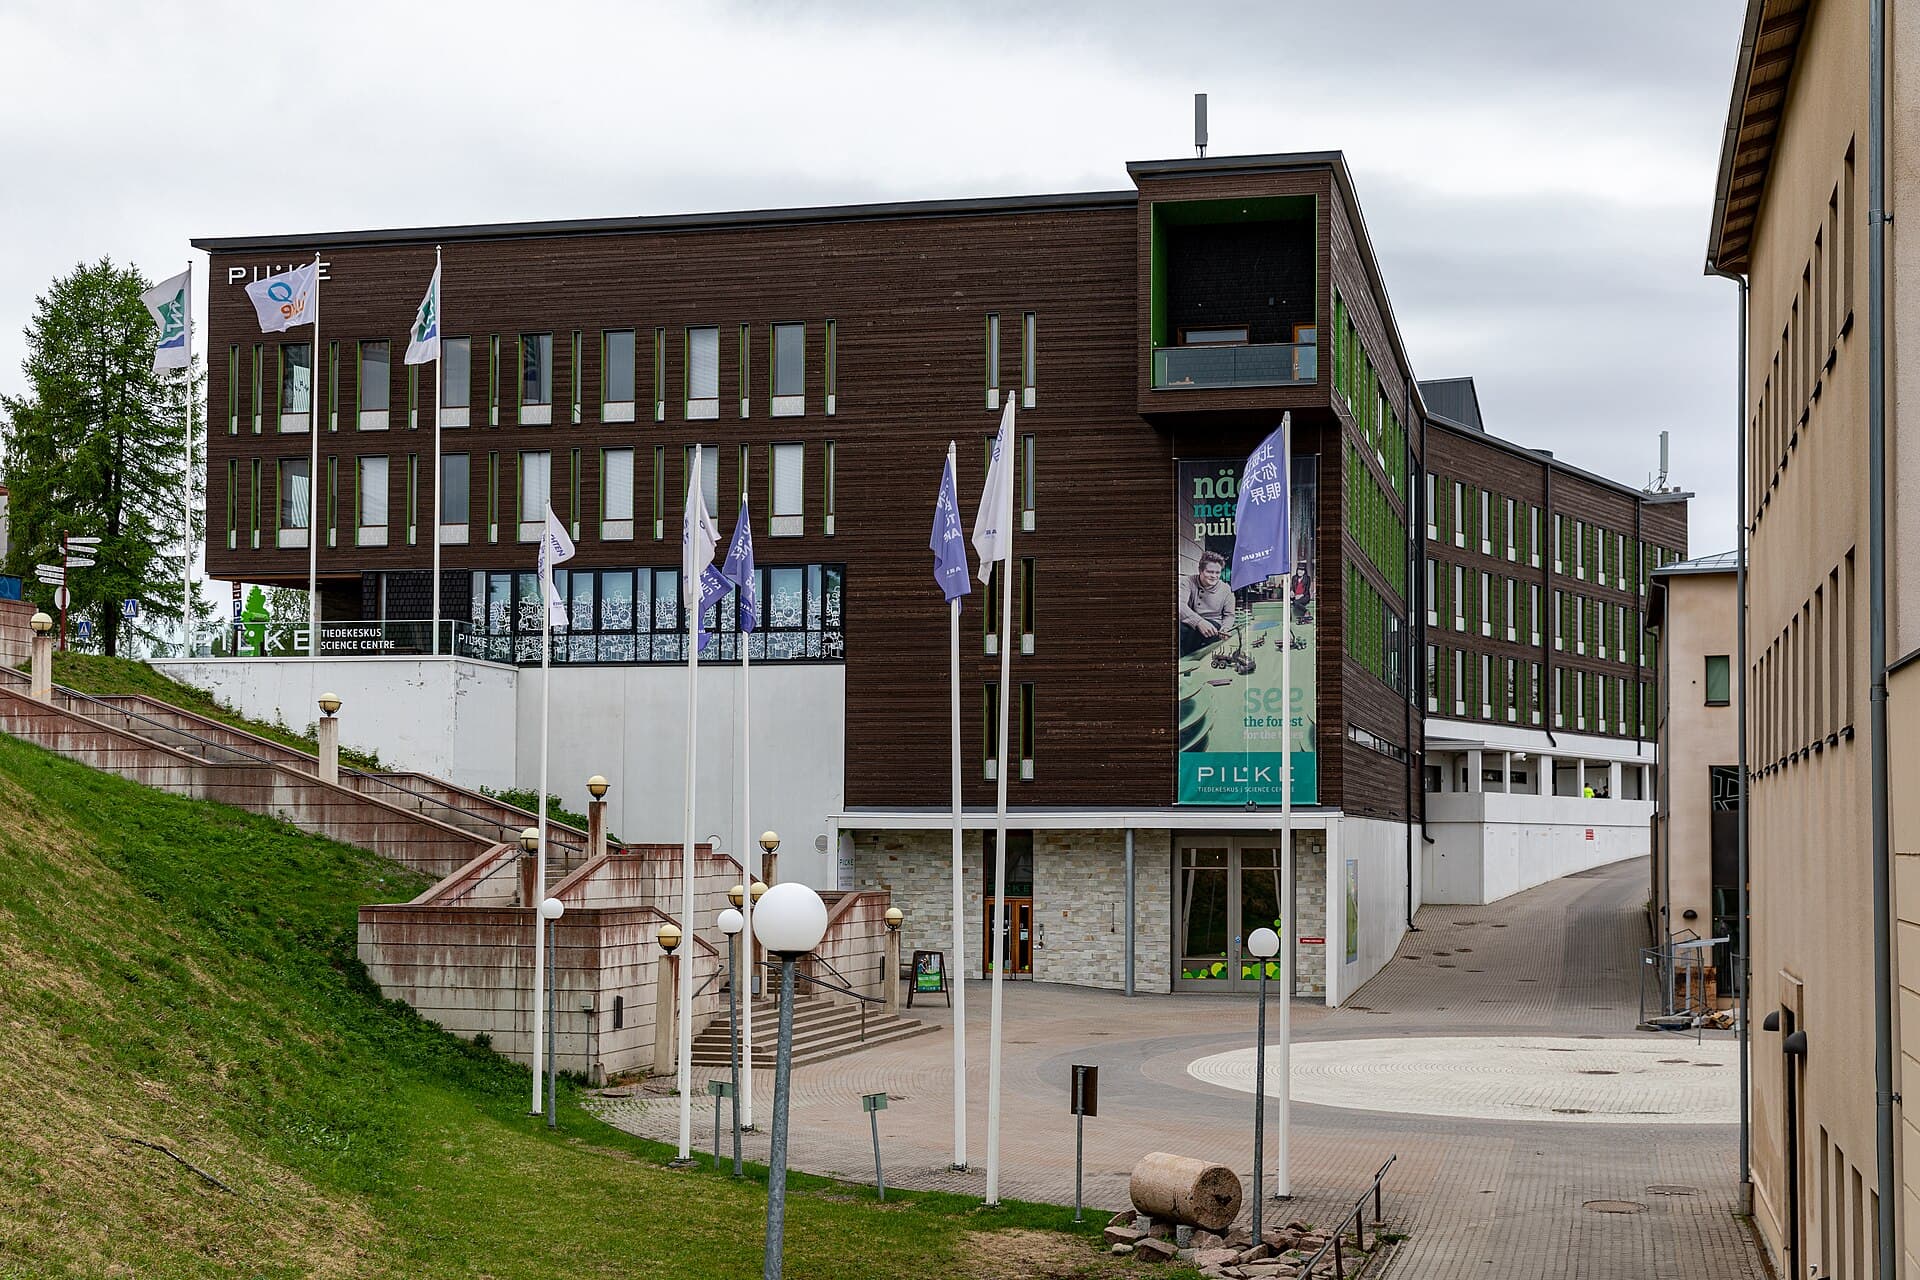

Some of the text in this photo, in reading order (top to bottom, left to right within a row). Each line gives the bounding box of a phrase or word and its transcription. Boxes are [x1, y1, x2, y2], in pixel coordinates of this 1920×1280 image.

[228, 262, 331, 285] PIE
[1193, 501, 1237, 518] mets
[1193, 518, 1237, 542] puil
[321, 628, 382, 638] TIEDEKESKUS
[320, 640, 395, 650] SCIENCE CENTRE
[1243, 687, 1304, 713] see
[1243, 715, 1303, 728] the forst
